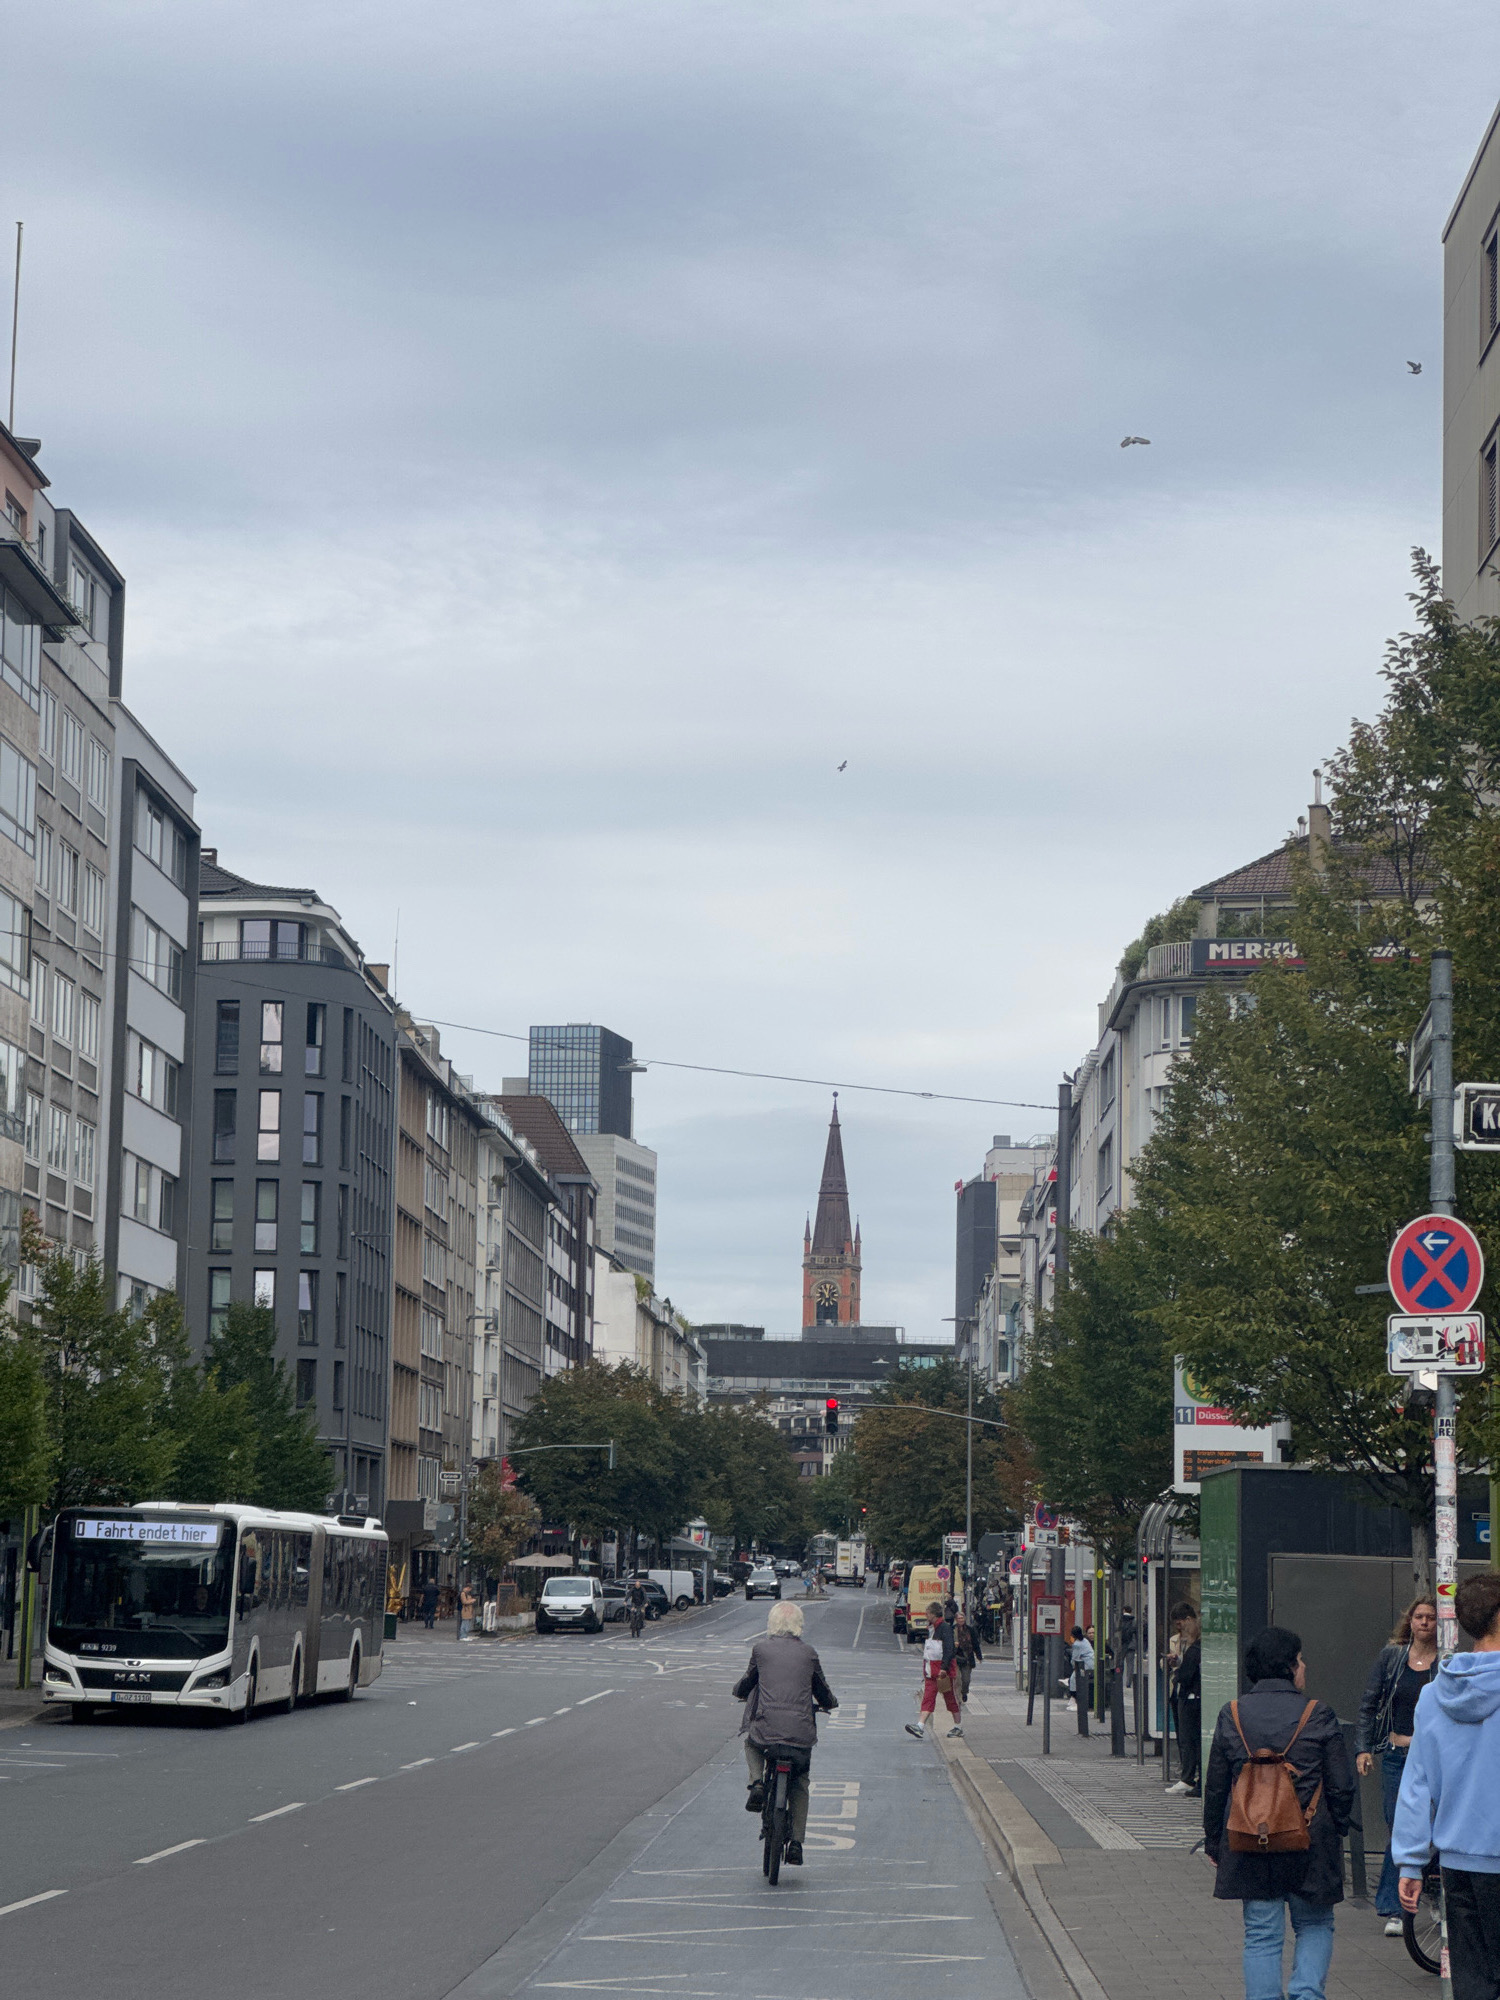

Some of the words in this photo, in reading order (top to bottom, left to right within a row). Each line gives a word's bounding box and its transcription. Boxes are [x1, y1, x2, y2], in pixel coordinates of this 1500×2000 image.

[1208, 942, 1299, 959] MERKU
[1482, 1102, 1500, 1130] K
[1177, 1408, 1192, 1423] 11
[1198, 1410, 1232, 1420] Düsse
[96, 1522, 134, 1539] Fahrt
[138, 1524, 177, 1540] endet
[181, 1525, 208, 1541] hier
[101, 1644, 117, 1652] 9239
[114, 1673, 151, 1683] MAN
